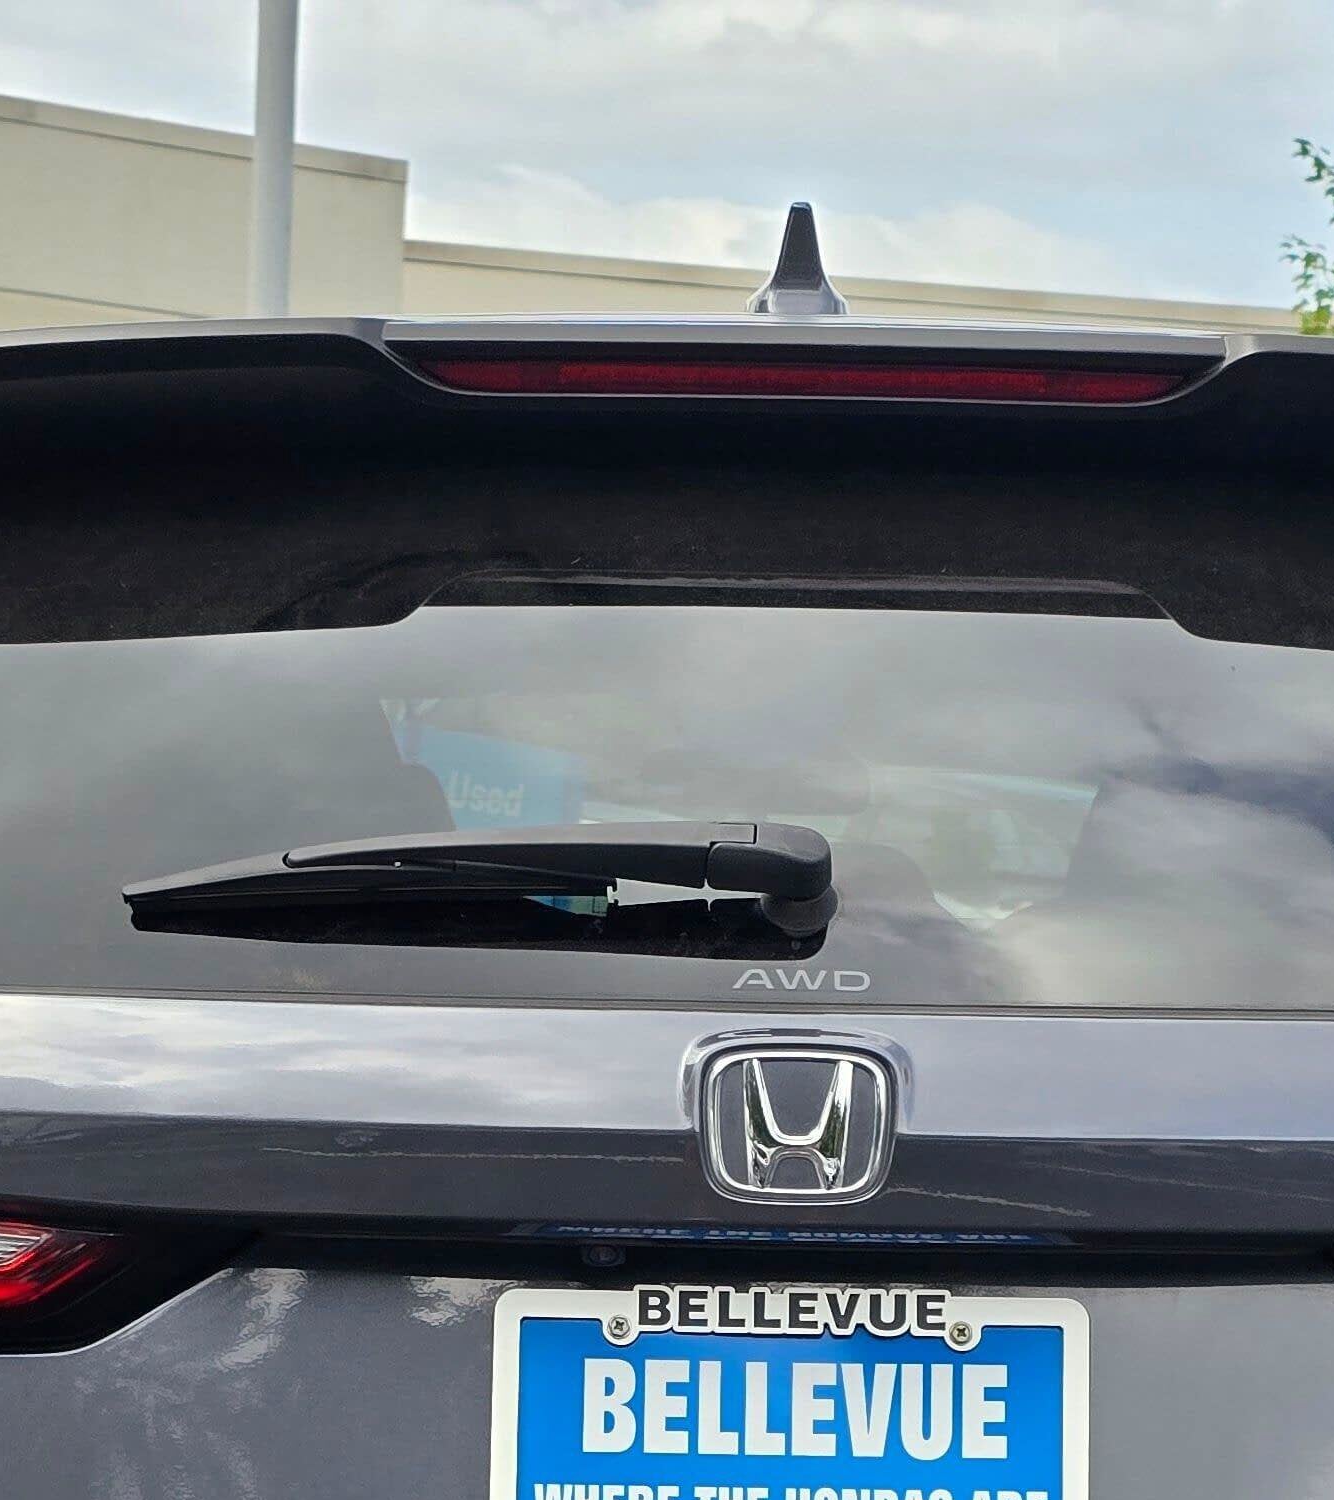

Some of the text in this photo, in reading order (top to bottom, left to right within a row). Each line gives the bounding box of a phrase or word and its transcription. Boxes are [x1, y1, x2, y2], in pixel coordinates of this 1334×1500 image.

[447, 767, 525, 817] Used
[732, 968, 871, 992] AWD
[637, 1289, 947, 1332] BELLEVUE
[581, 1357, 1009, 1460] BELLEVUE
